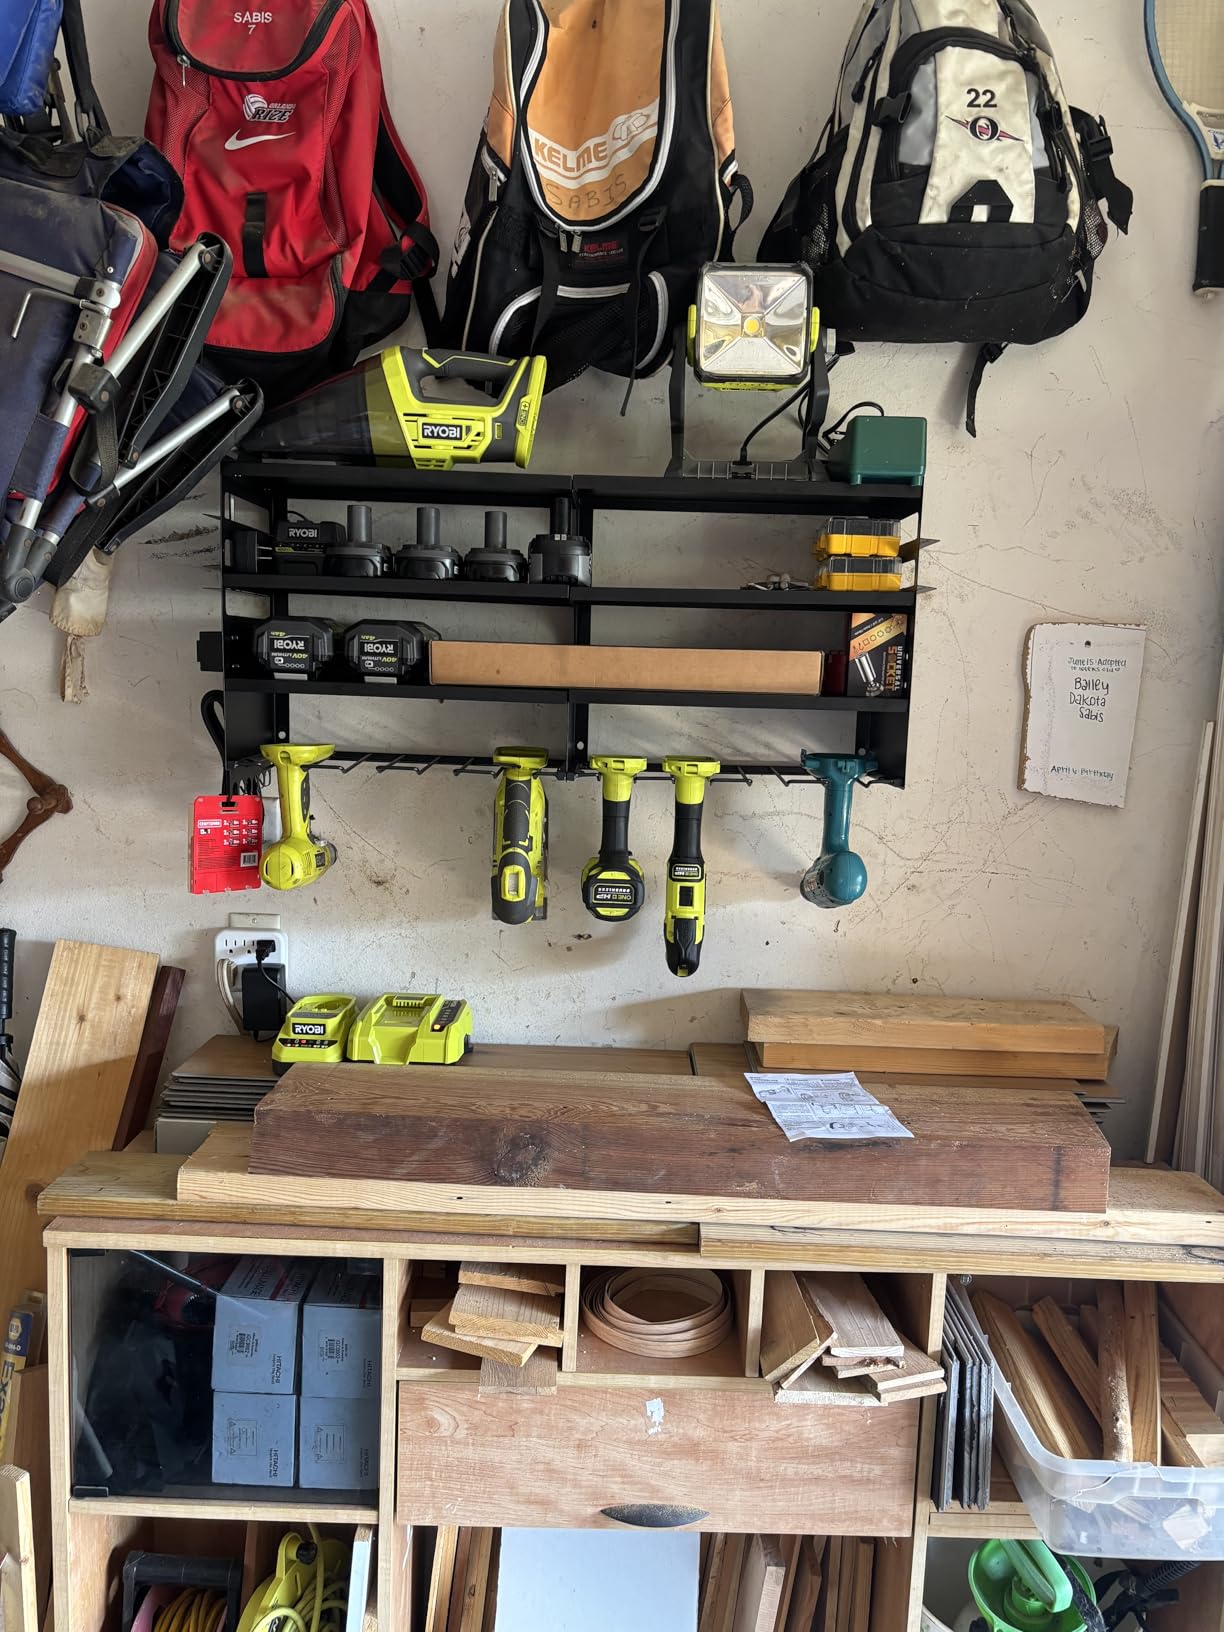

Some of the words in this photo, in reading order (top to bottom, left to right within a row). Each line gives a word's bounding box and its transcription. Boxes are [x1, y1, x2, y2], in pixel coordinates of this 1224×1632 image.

[233, 11, 273, 24] SABIS
[247, 24, 256, 35] 7
[966, 87, 998, 108] 22
[251, 108, 293, 122] RIZE
[532, 137, 608, 173] KELME
[543, 172, 628, 210] SABIS
[423, 424, 461, 438] RYOBI
[288, 528, 318, 538] RYOBI
[274, 639, 305, 650] RYOBI
[364, 643, 394, 654] RYOBI
[894, 645, 903, 691] UNIVERSAL
[1069, 691, 1106, 707] Dakota
[1079, 706, 1104, 723] Sabis
[294, 1024, 324, 1034] RYOBI
